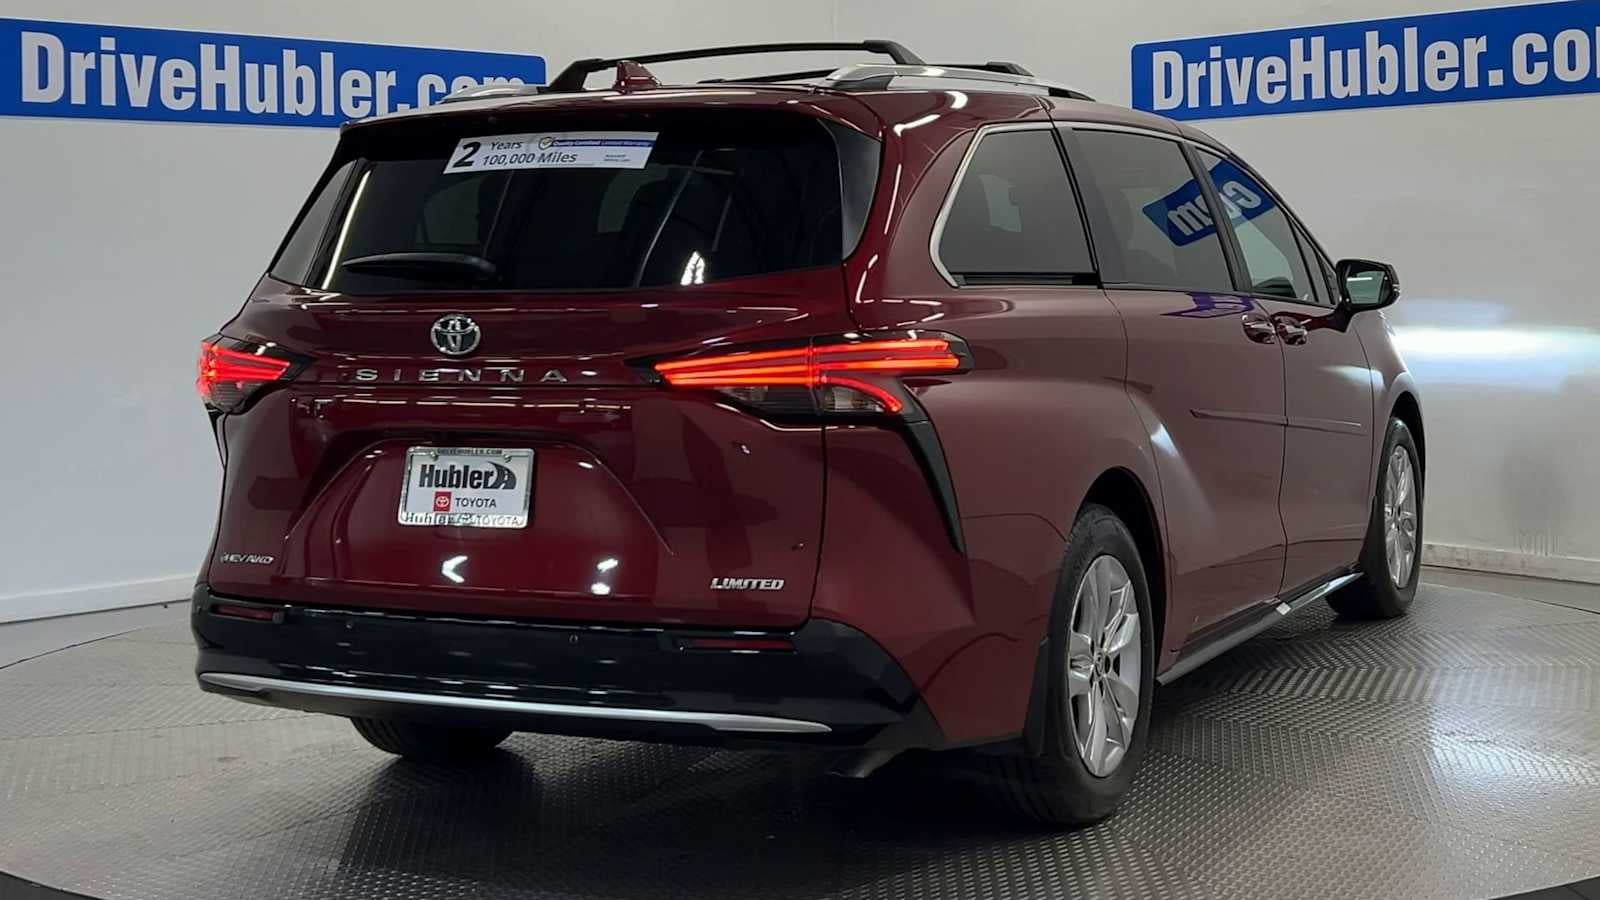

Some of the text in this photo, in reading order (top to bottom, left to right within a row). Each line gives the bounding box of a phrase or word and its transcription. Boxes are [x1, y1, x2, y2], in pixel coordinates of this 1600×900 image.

[20, 31, 525, 118] DriveHubler.c
[1152, 26, 1600, 111] DriveHubler.co
[490, 141, 523, 151] Years
[452, 142, 481, 168] 2
[483, 152, 577, 166] 100,000 Miles
[355, 368, 568, 382] SIENNA
[419, 464, 495, 490] Hubler
[455, 498, 497, 508] TOYOTA
[710, 577, 785, 590] LIMITED
